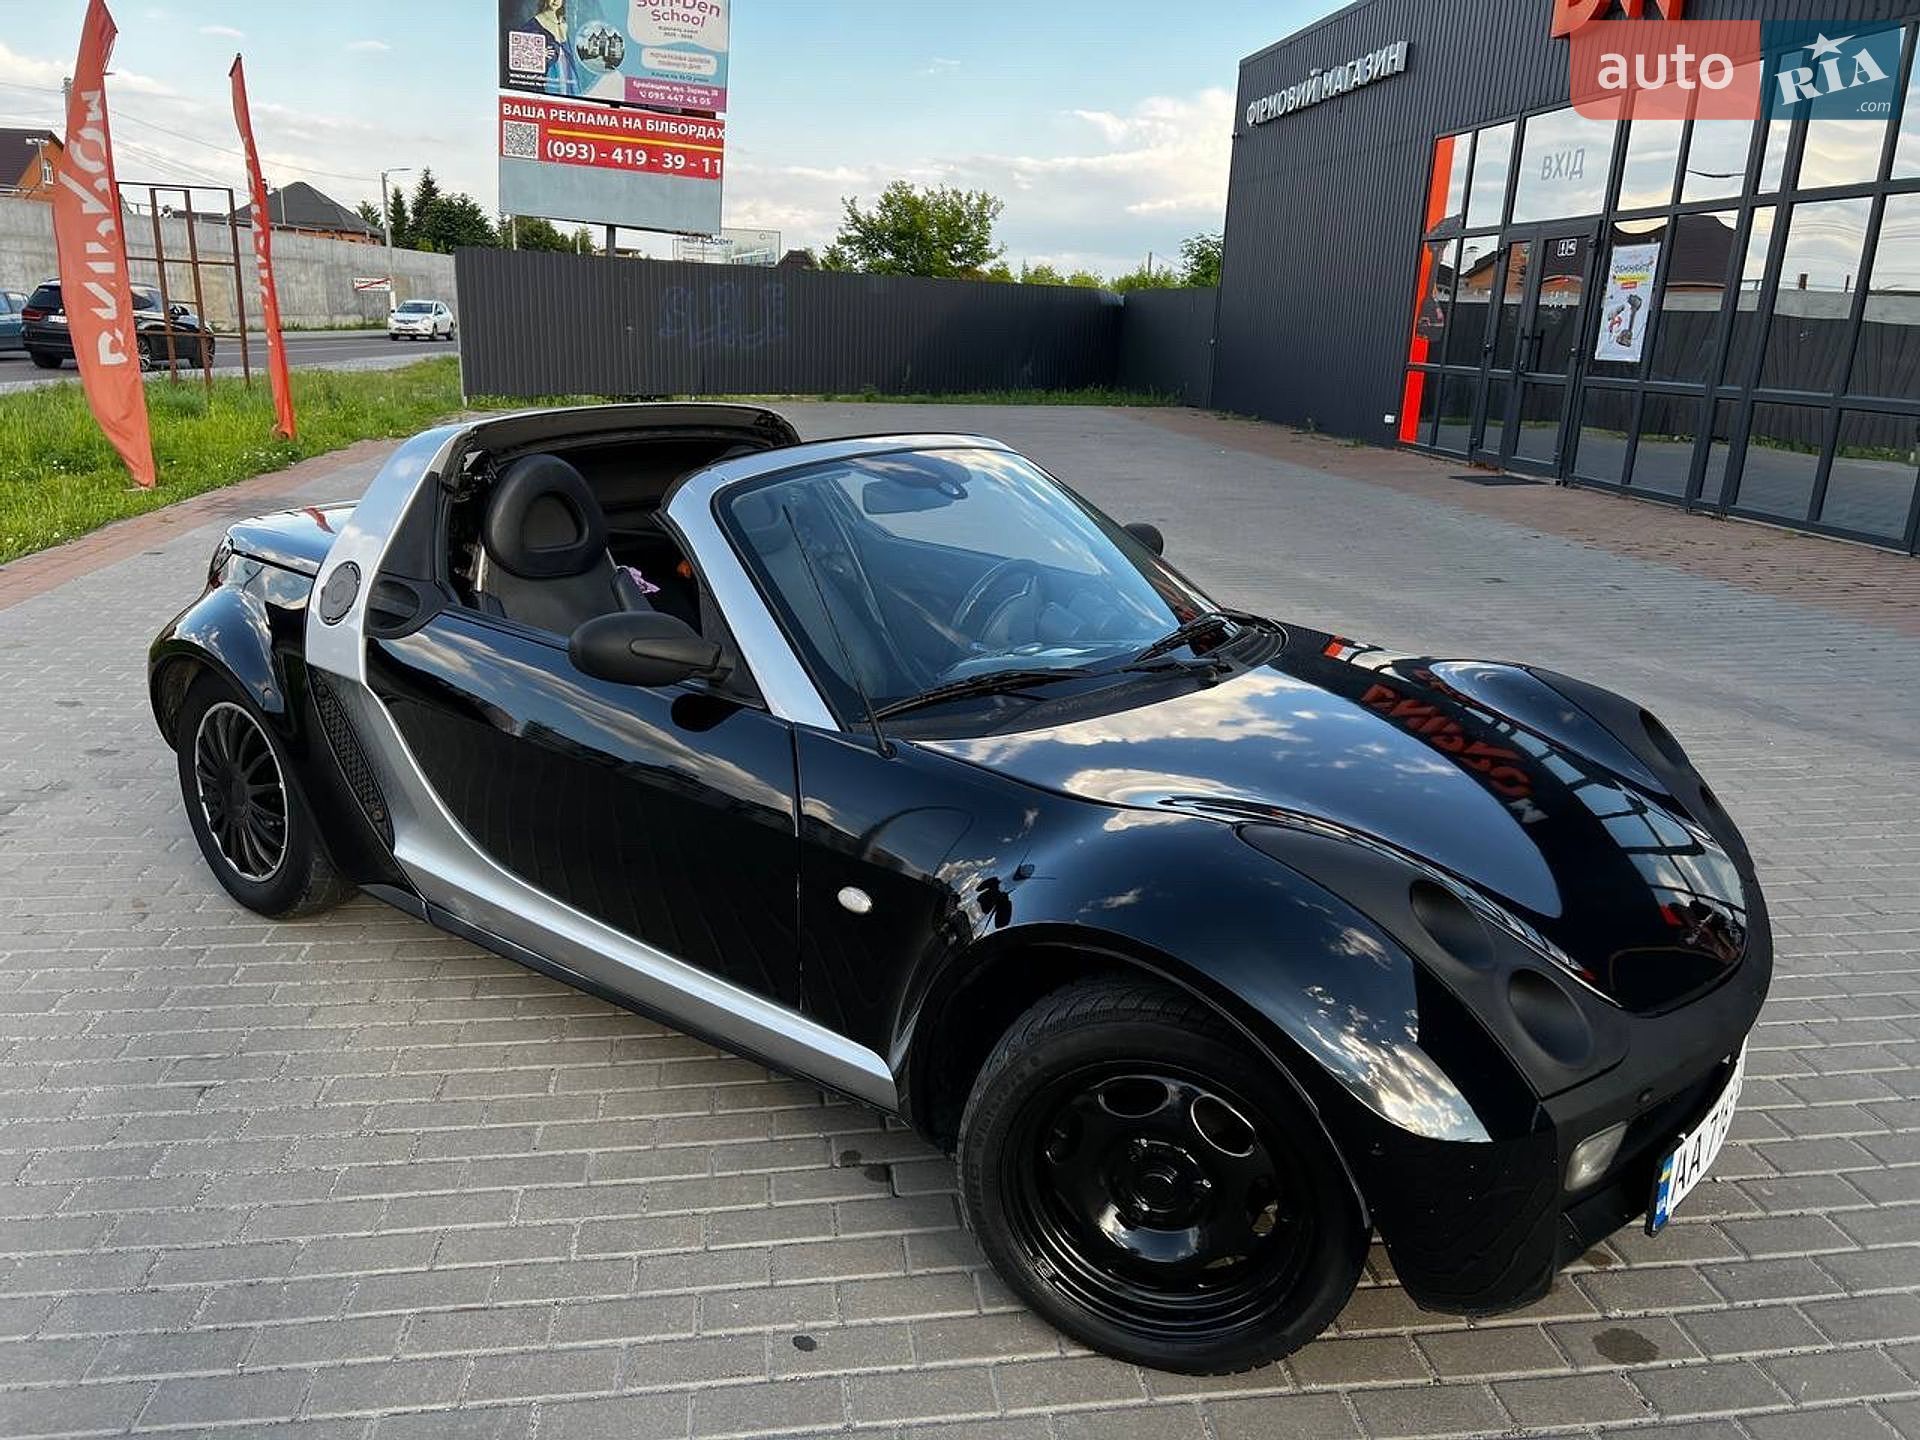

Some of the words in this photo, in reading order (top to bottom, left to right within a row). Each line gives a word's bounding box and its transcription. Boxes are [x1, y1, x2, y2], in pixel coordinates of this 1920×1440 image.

[651, 9, 706, 27] School
[1246, 68, 1323, 126] ФІРМОВИЙ
[1321, 40, 1409, 99] МАГАЗИН
[503, 104, 547, 120] ВАША
[550, 108, 619, 128] РЕКЛАМА
[622, 117, 643, 131] НА
[646, 120, 725, 140] БІЛБОРДАХ
[547, 139, 595, 162] (093)
[612, 147, 648, 166] 419
[662, 152, 686, 170] 39
[702, 158, 722, 174] 11
[1541, 148, 1585, 182] ВХІД
